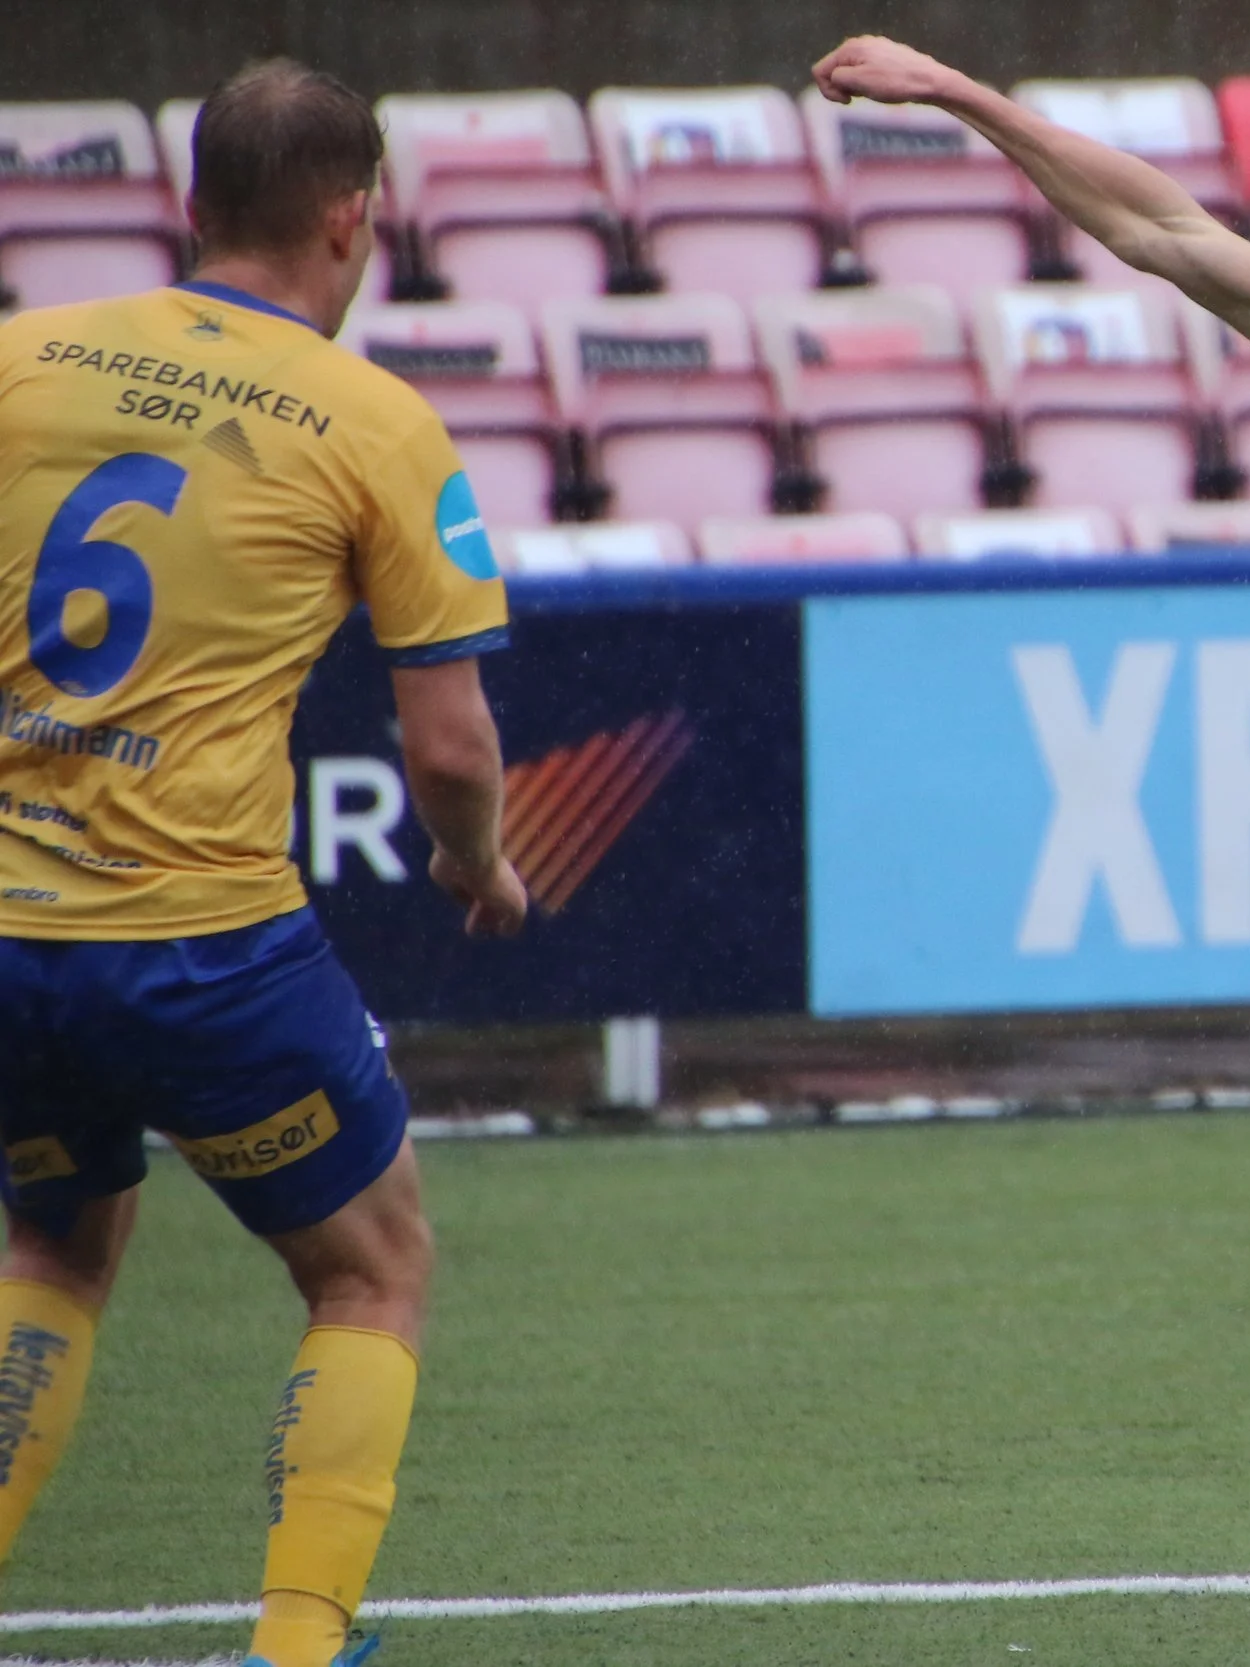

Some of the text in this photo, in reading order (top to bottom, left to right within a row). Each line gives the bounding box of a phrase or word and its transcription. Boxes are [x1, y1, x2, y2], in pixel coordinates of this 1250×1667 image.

[37, 341, 332, 437] SPAREBANKEN
[115, 388, 201, 430] SØR
[27, 452, 188, 698] 6
